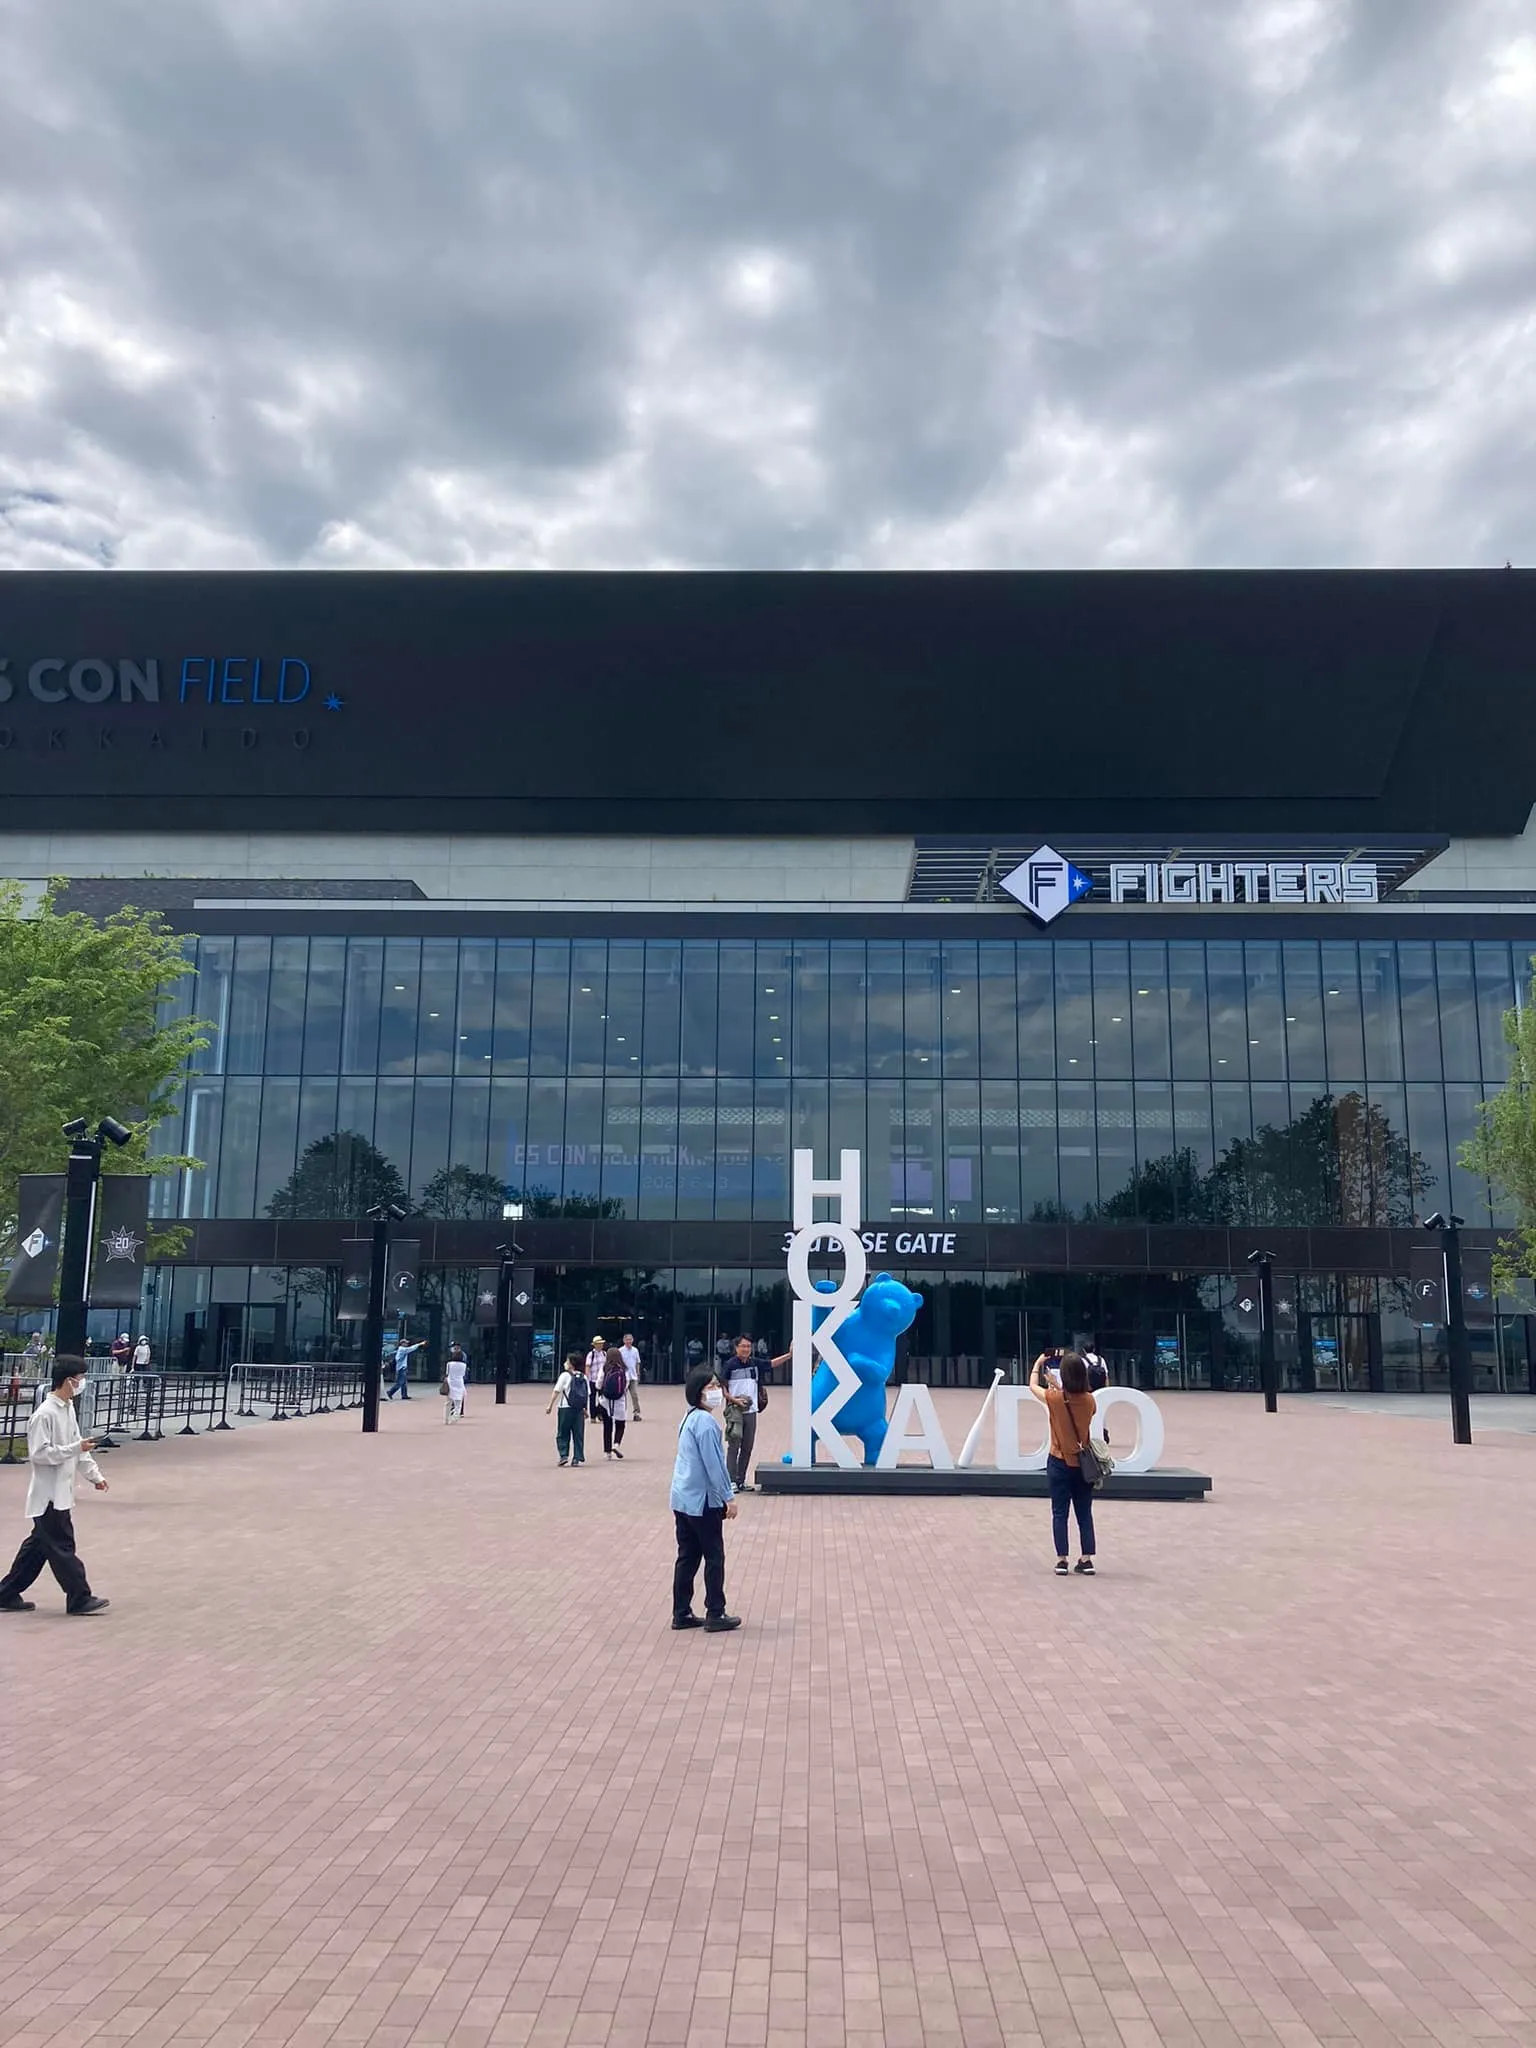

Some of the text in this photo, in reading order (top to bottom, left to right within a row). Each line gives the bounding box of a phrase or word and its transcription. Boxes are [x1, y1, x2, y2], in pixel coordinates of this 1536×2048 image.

[28, 658, 160, 704] CON
[179, 657, 312, 704] FIELD
[1028, 861, 1379, 908] F FIGHTERS
[115, 1237, 129, 1249] 20
[827, 1232, 889, 1254] BSE
[895, 1232, 957, 1254] GATE
